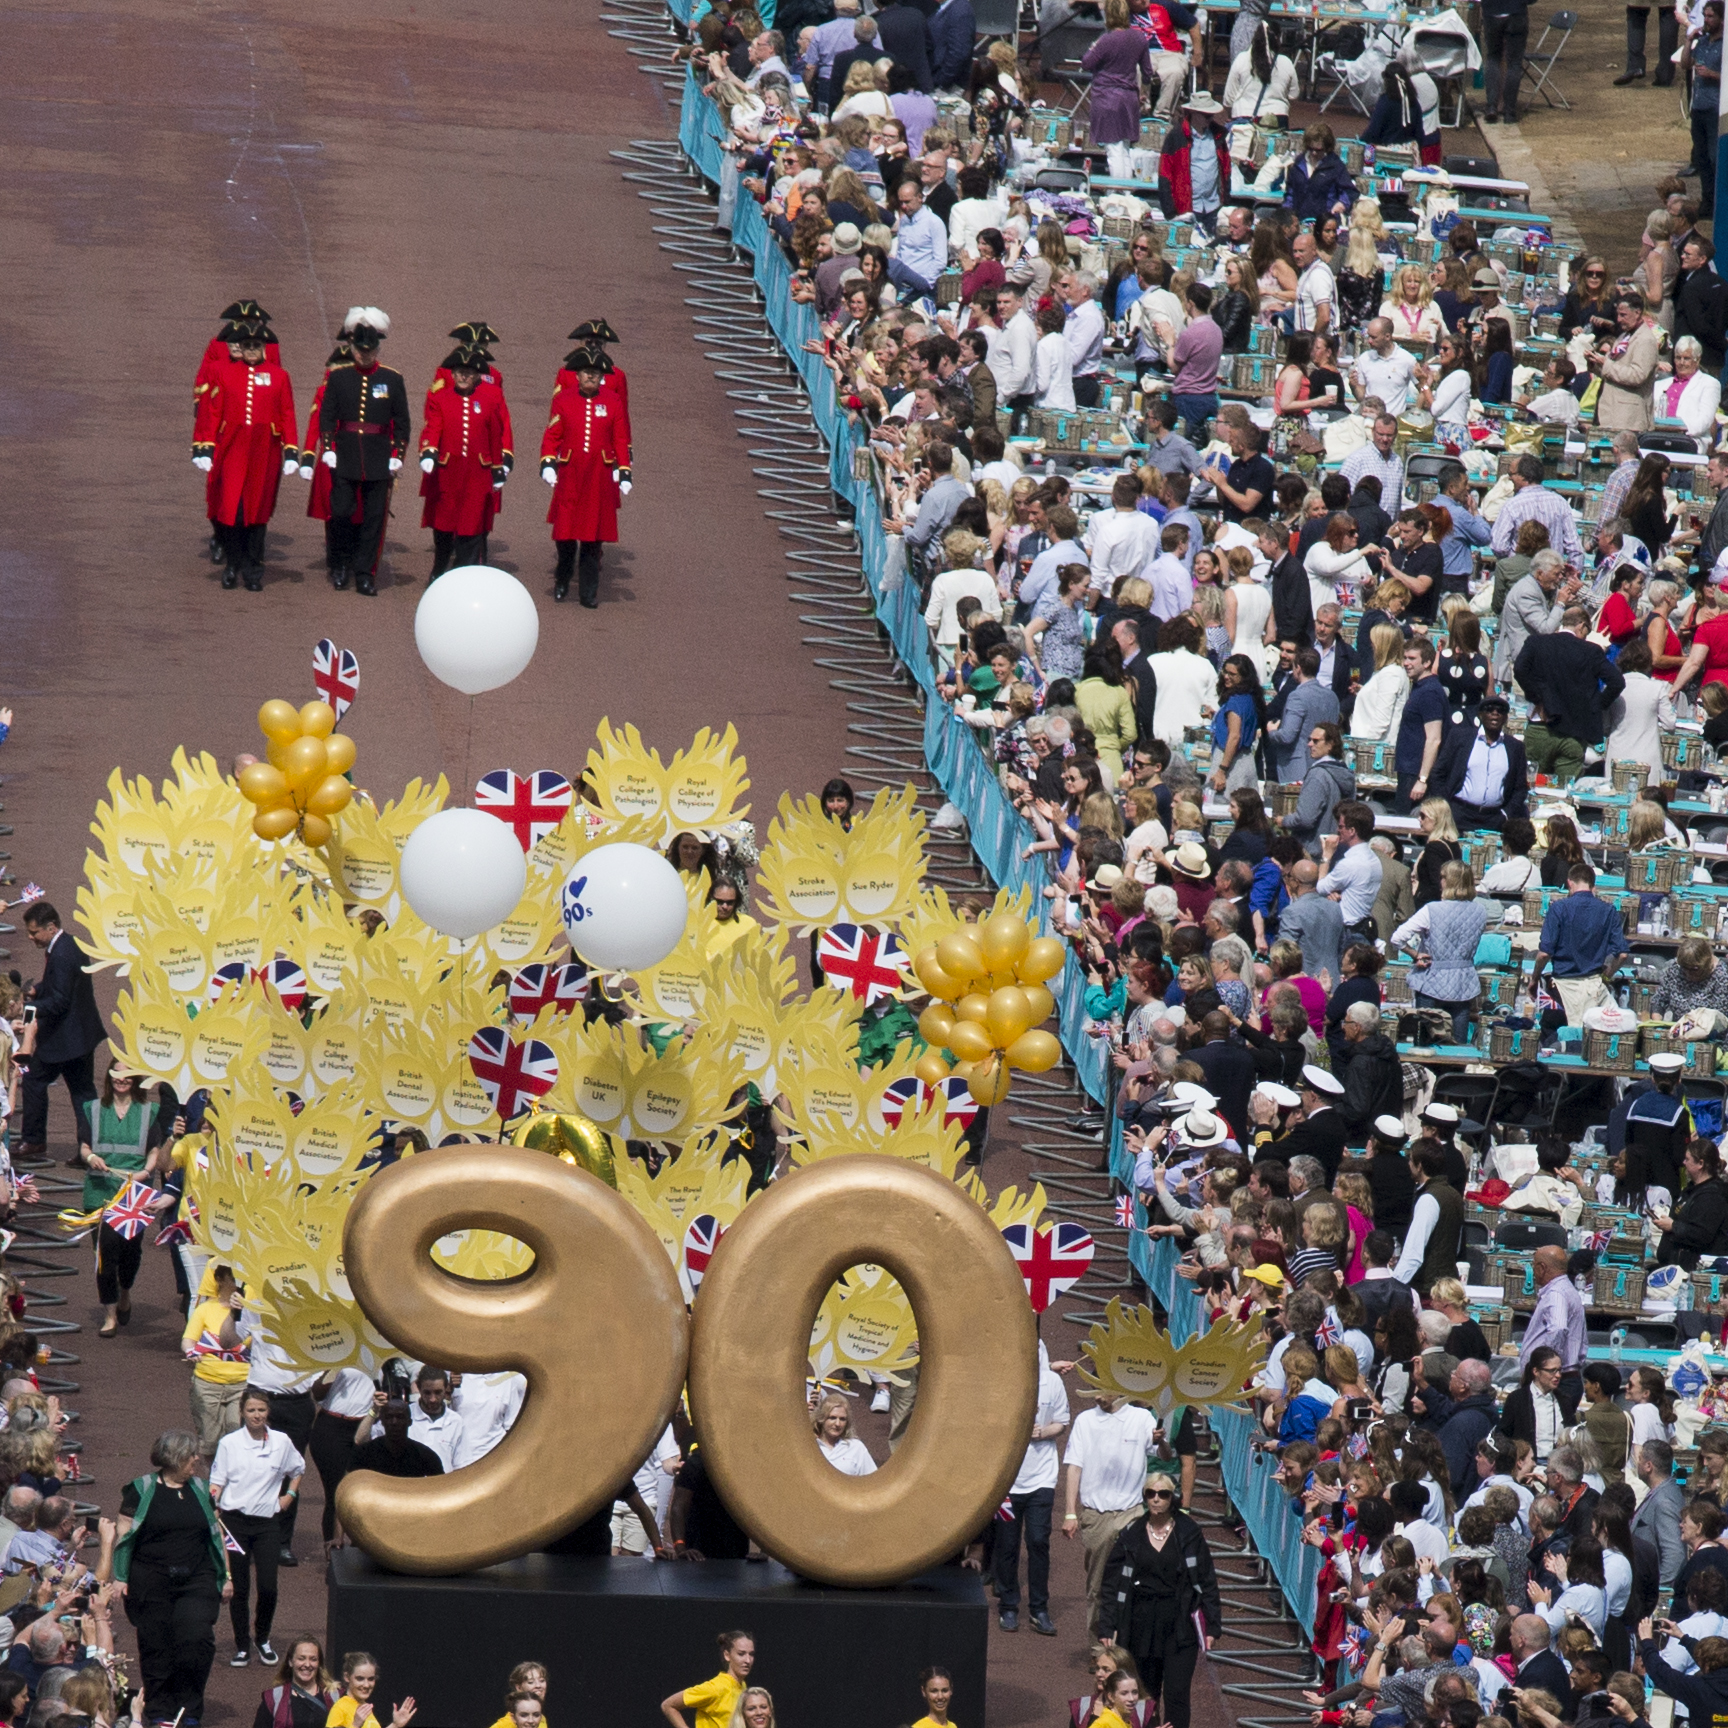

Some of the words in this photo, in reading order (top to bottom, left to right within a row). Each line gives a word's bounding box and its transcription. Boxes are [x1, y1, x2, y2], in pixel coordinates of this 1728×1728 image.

[626, 774, 646, 784] Royal
[687, 778, 706, 788] Royal
[619, 785, 644, 796] College
[678, 788, 703, 798] College
[615, 795, 658, 807] Pathologists
[678, 799, 714, 810] Physicians
[550, 830, 566, 842] Royal
[535, 845, 544, 853] for
[542, 838, 566, 852] Hospital
[344, 855, 392, 866] Commonwealth
[798, 876, 825, 886] Stroke
[870, 881, 894, 892] Ryder
[348, 882, 383, 892] Association
[789, 888, 836, 898] Association
[563, 902, 594, 930] 90s
[500, 927, 531, 938] Engineers
[216, 941, 236, 950] Royal
[236, 937, 260, 948] Society
[325, 942, 344, 952] Royal
[500, 937, 529, 946] Australia
[169, 947, 188, 956] Royal
[234, 948, 256, 958] Public
[319, 952, 347, 962] Medical
[181, 955, 202, 964] Alfred
[168, 968, 196, 978] Hospital
[676, 979, 700, 988] Hospital
[370, 996, 382, 1005] The
[384, 999, 407, 1008] British
[140, 1023, 158, 1034] Royal
[159, 1026, 182, 1038] Surrey
[146, 1036, 172, 1048] County
[199, 1034, 218, 1045] Royal
[220, 1038, 243, 1048] Sussex
[272, 1032, 288, 1041] Royal
[750, 1035, 765, 1044] NHS
[326, 1040, 345, 1049] Royal
[144, 1047, 172, 1059] Hospital
[207, 1046, 232, 1058] County
[324, 1050, 348, 1061] College
[266, 1061, 298, 1070] Melbourne
[328, 1062, 354, 1074] Nursing
[398, 1070, 424, 1080] British
[397, 1080, 422, 1091] Dental
[583, 1076, 618, 1092] Diabetes
[386, 1090, 430, 1102] Association
[452, 1090, 484, 1101] Institute
[592, 1091, 606, 1102] UK
[646, 1090, 681, 1106] Epilepsy
[813, 1090, 826, 1098] King
[454, 1100, 490, 1114] Radiology
[826, 1100, 852, 1108] Hospital
[646, 1102, 677, 1118] Society
[251, 1116, 276, 1127] British
[241, 1126, 272, 1138] Hospital
[274, 1131, 282, 1139] in
[312, 1128, 338, 1138] British
[236, 1136, 262, 1148] Buenos
[264, 1141, 284, 1151] Aires
[308, 1139, 338, 1150] Medical
[299, 1149, 342, 1162] Association
[218, 1198, 234, 1210] Royal
[214, 1212, 234, 1224] London
[212, 1224, 235, 1238] Hospital
[268, 1262, 307, 1274] Canadian
[310, 1320, 332, 1332] Royal
[848, 1313, 866, 1324] Royal
[867, 1318, 890, 1330] Society
[308, 1330, 340, 1342] Victoria
[858, 1326, 884, 1337] Tropical
[847, 1333, 876, 1345] Medicine
[311, 1338, 344, 1352] Hospital
[852, 1343, 878, 1354] Hygiene
[335, 1145, 1038, 1587] 90
[1118, 1356, 1144, 1366] British
[1146, 1360, 1162, 1368] Red
[1190, 1358, 1226, 1368] Canadian
[1126, 1368, 1148, 1376] Cross
[1192, 1368, 1220, 1377] Cancer
[1189, 1377, 1218, 1388] Society
